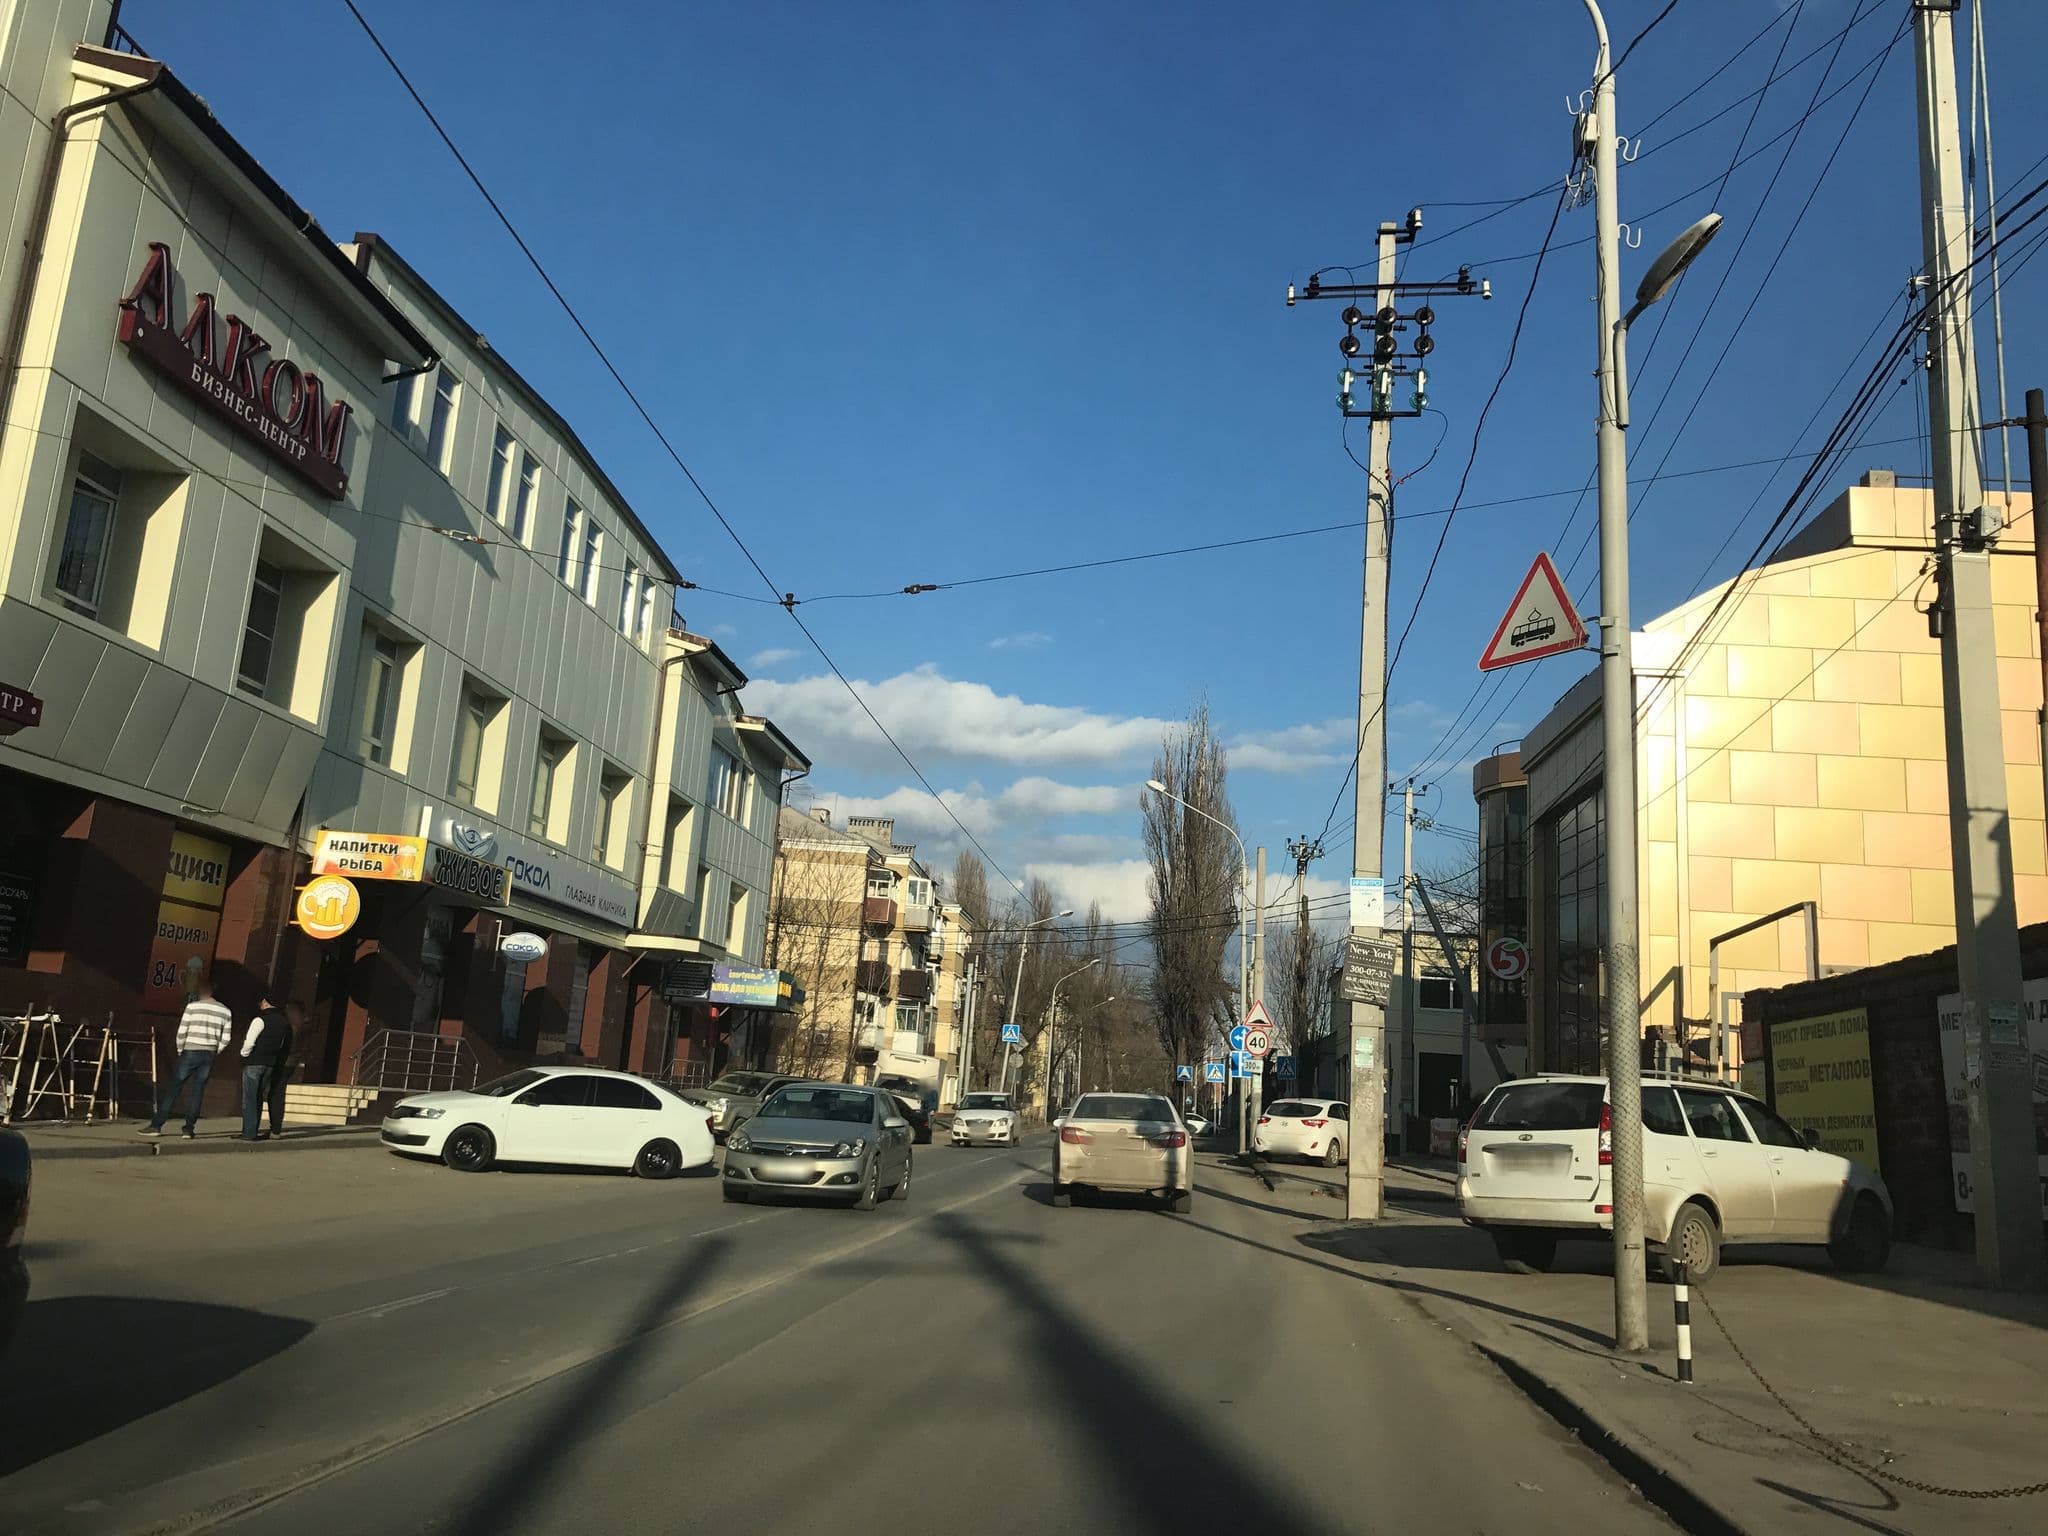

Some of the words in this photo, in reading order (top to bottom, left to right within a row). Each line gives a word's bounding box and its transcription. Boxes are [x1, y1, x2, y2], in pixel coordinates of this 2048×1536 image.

[119, 241, 354, 466] АЛКОМ
[190, 363, 308, 462] БИЗНЕС-ЦЕНТР
[330, 838, 399, 855] НАПИТКИ
[339, 857, 383, 871] РЫБА
[435, 848, 504, 900] ЖИВОЕ
[566, 885, 596, 906] ГЛАЗНАЯ
[598, 898, 627, 918] КЛИНИКА
[506, 943, 540, 954] СОКОЛ
[1350, 943, 1370, 956] New
[1372, 948, 1394, 960] York
[1349, 965, 1387, 979] 300-07-31
[1773, 1028, 1798, 1048] ПУНКТ
[1800, 1021, 1837, 1041] ПРИЕМА
[1840, 1016, 1869, 1036] ЛОМА
[1249, 1037, 1266, 1049] 40
[1809, 1058, 1870, 1084] МЕТАЛЛОВ
